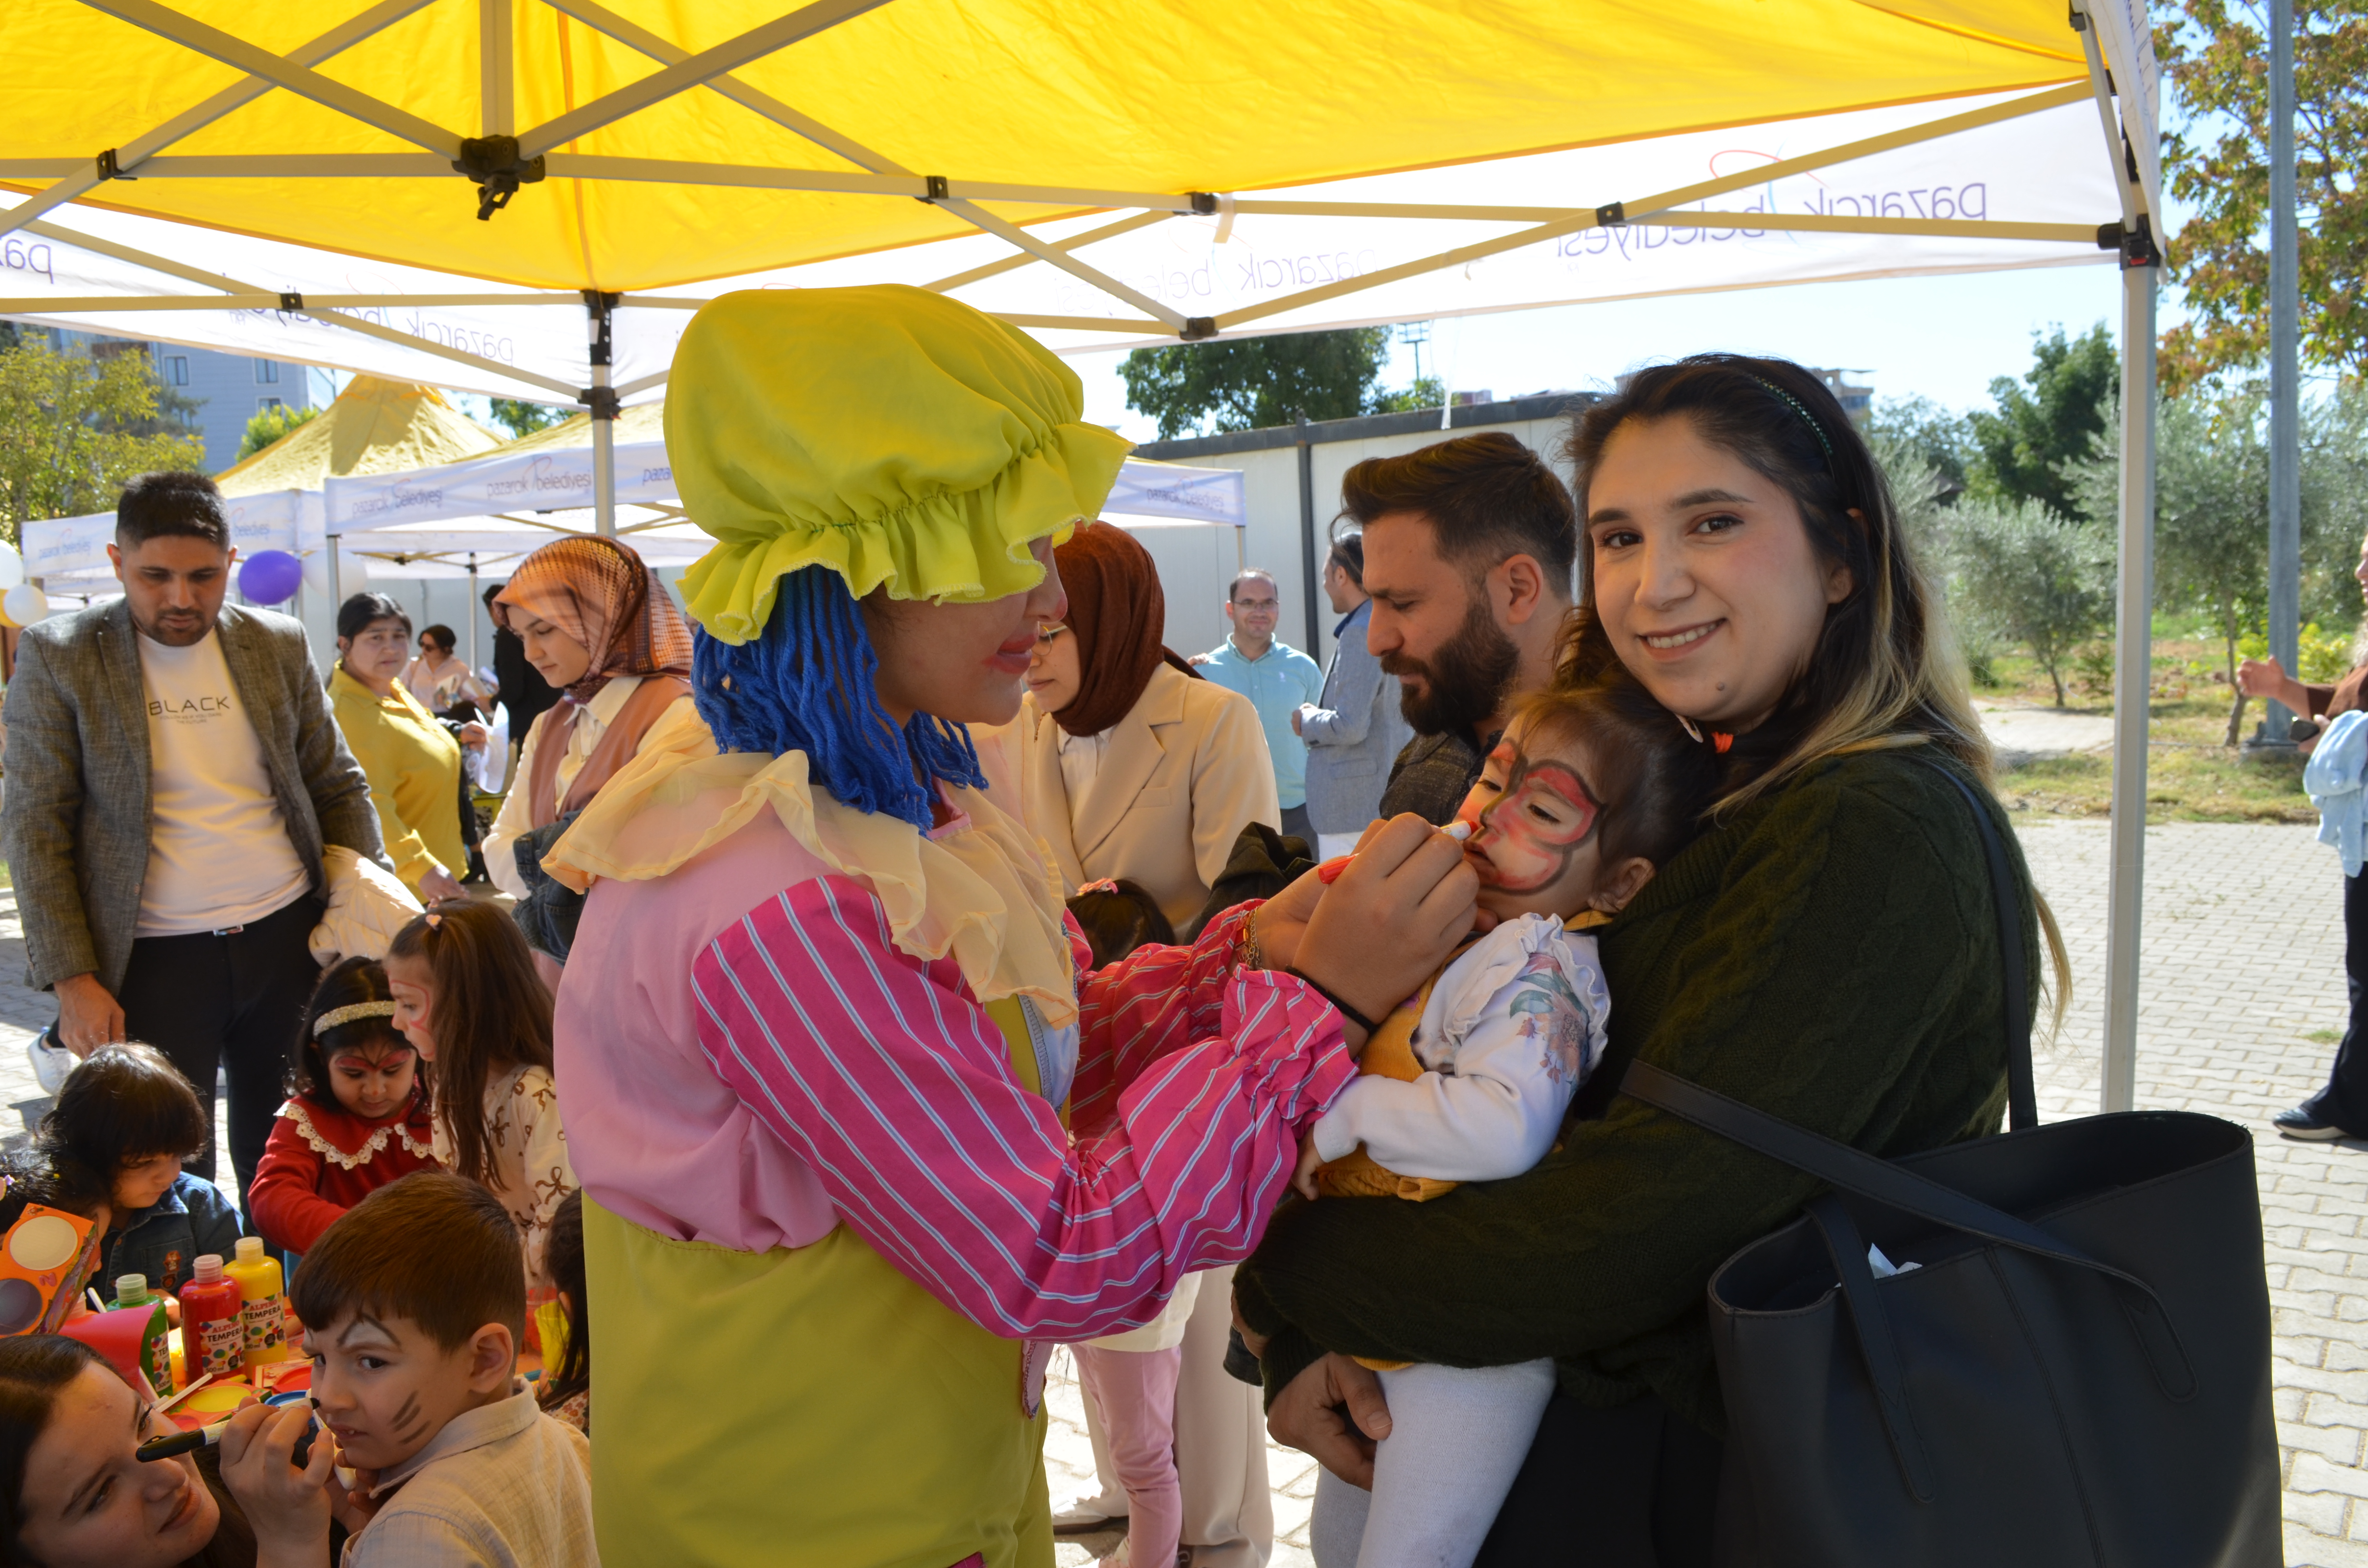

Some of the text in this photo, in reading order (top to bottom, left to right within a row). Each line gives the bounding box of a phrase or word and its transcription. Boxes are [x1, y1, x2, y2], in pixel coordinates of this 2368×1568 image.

[148, 696, 230, 716] BLACK
[244, 1305, 281, 1320] TEMPERA
[249, 1299, 277, 1311] ALPINO
[207, 1326, 243, 1342] TEMPERA
[211, 1320, 239, 1334] ALPINO
